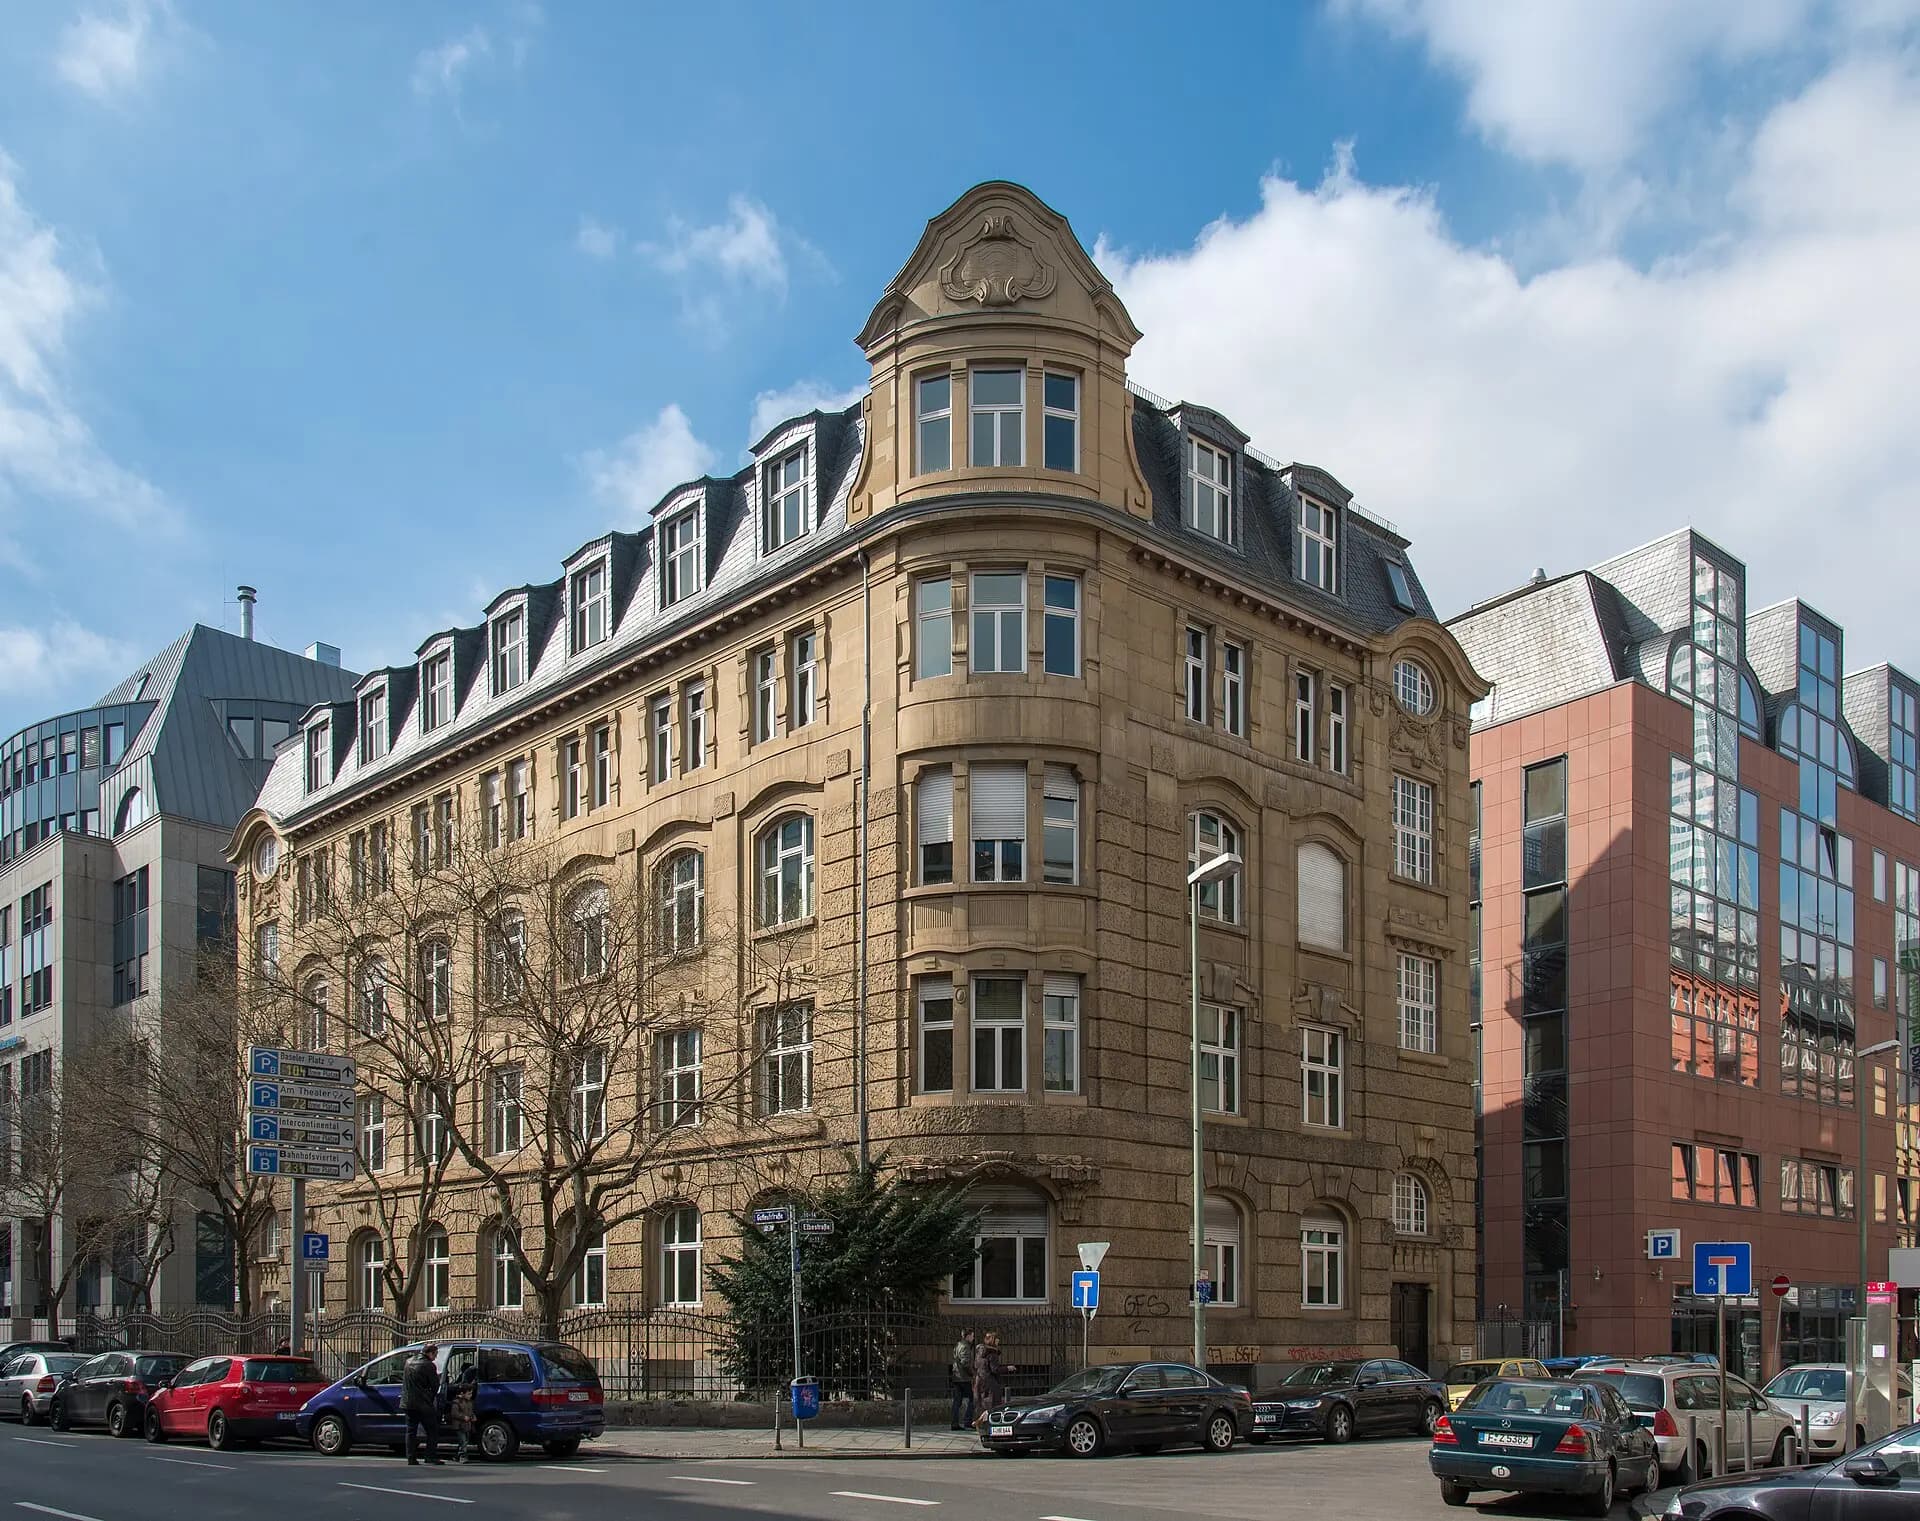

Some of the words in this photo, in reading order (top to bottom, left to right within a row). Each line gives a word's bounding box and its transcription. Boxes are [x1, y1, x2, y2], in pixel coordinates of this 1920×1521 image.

[280, 1052, 305, 1063] Baseler
[308, 1055, 325, 1066] Platz
[280, 1085, 295, 1095] Am
[299, 1086, 331, 1098] Theater
[279, 1117, 340, 1131] Intercontinental
[279, 1149, 340, 1163] Bahnhofsviertel
[260, 1157, 270, 1171] B
[308, 1237, 323, 1257] P
[1658, 1239, 1669, 1255] P
